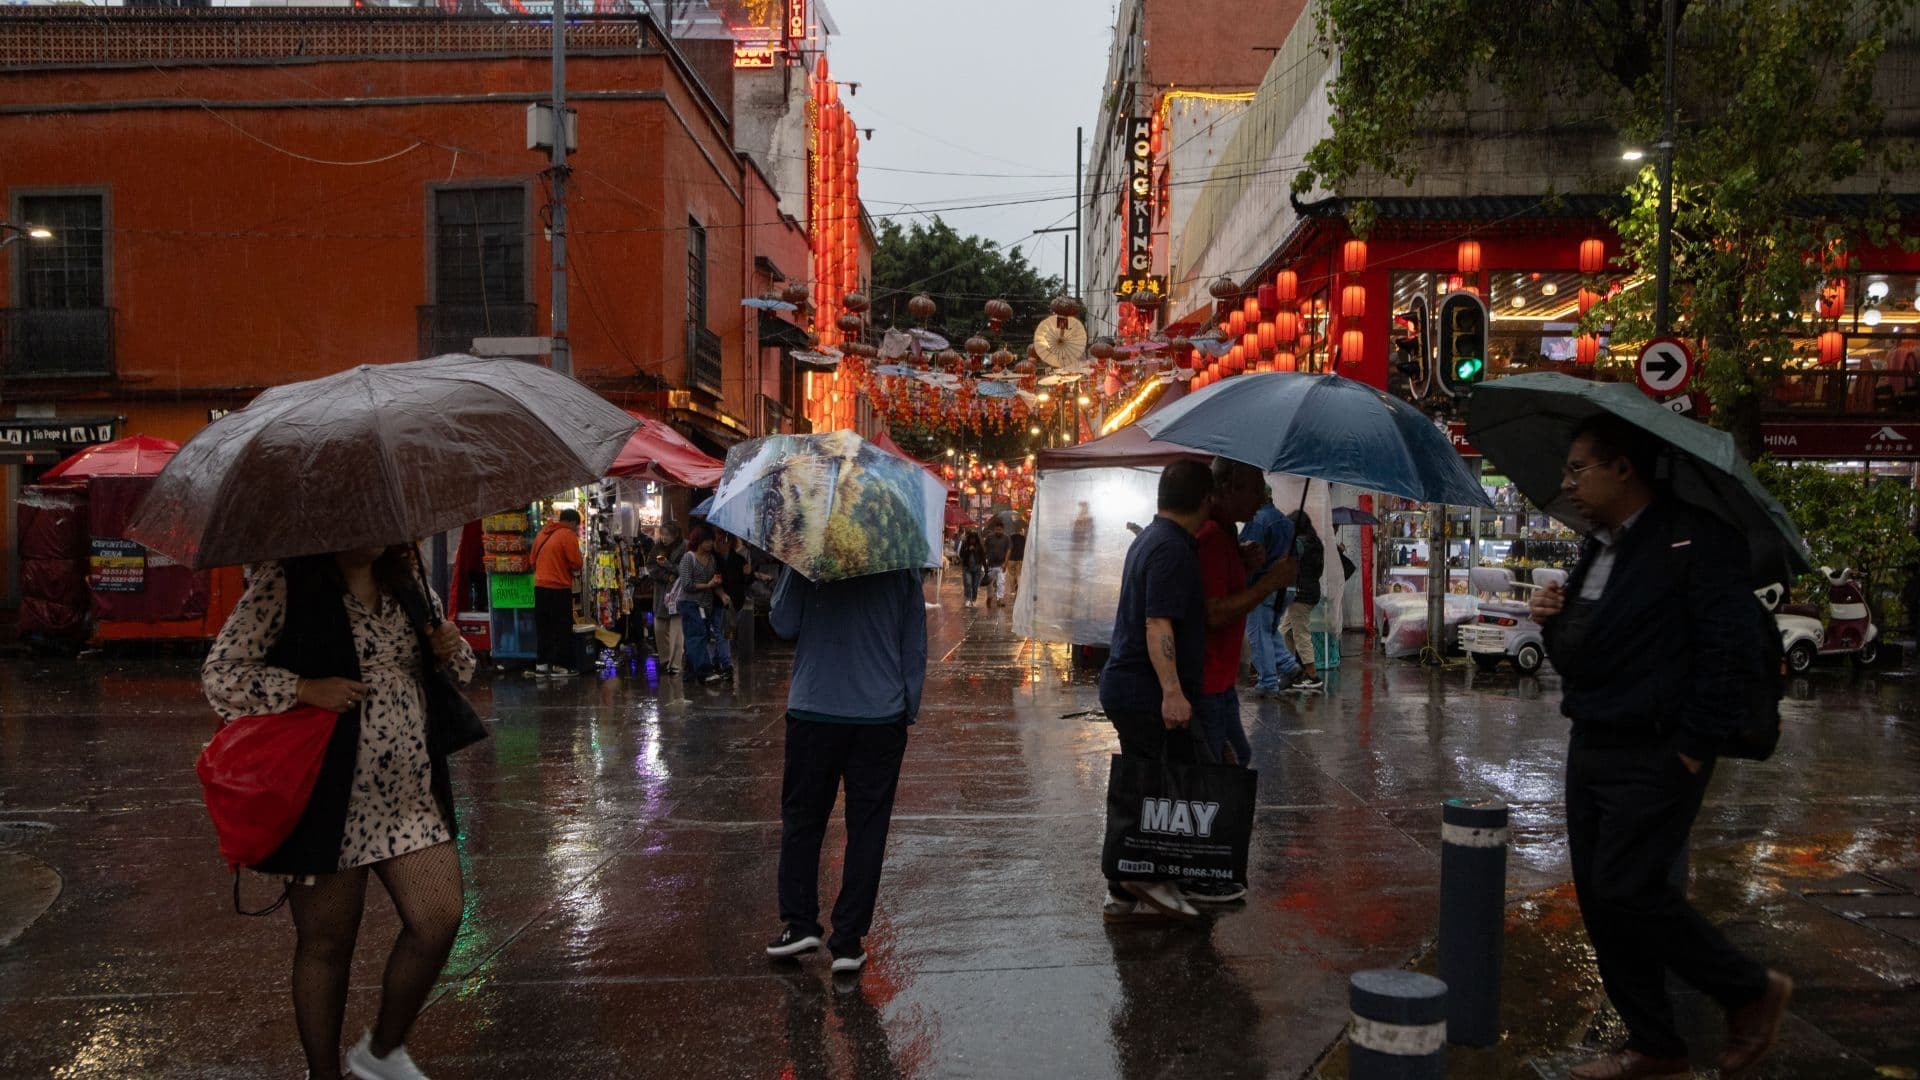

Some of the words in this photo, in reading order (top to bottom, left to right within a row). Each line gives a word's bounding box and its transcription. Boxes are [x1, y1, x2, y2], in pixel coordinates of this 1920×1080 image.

[44, 429, 60, 441] Pepe
[1763, 434, 1798, 446] HINA
[1141, 797, 1220, 837] MAY
[1168, 865, 1181, 875] 55
